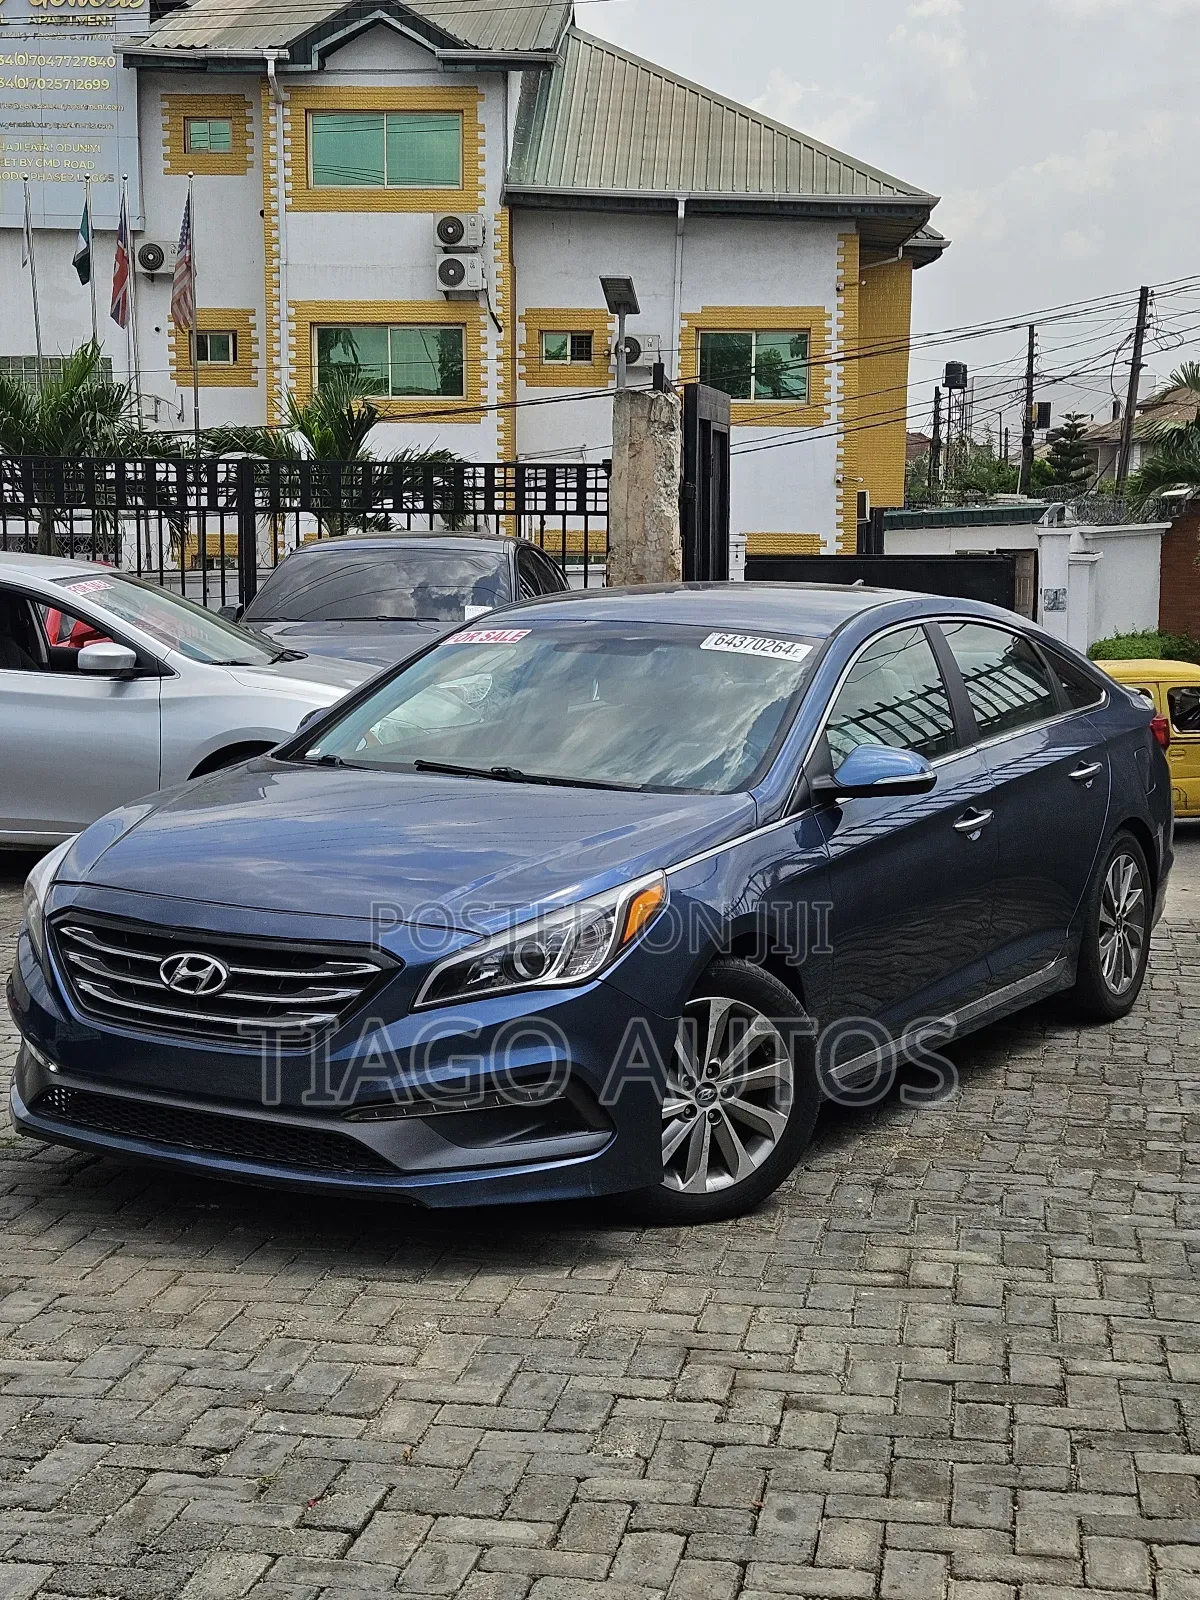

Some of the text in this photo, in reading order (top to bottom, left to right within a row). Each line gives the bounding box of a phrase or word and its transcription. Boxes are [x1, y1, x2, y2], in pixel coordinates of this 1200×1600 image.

[28, 14, 116, 27] APARTMENT
[55, 143, 102, 154] ODUNIYI
[19, 158, 34, 168] BY
[35, 158, 61, 169] CMD
[63, 160, 95, 170] ROAD
[440, 631, 528, 644] FOR SALE
[714, 634, 796, 655] 64370264
